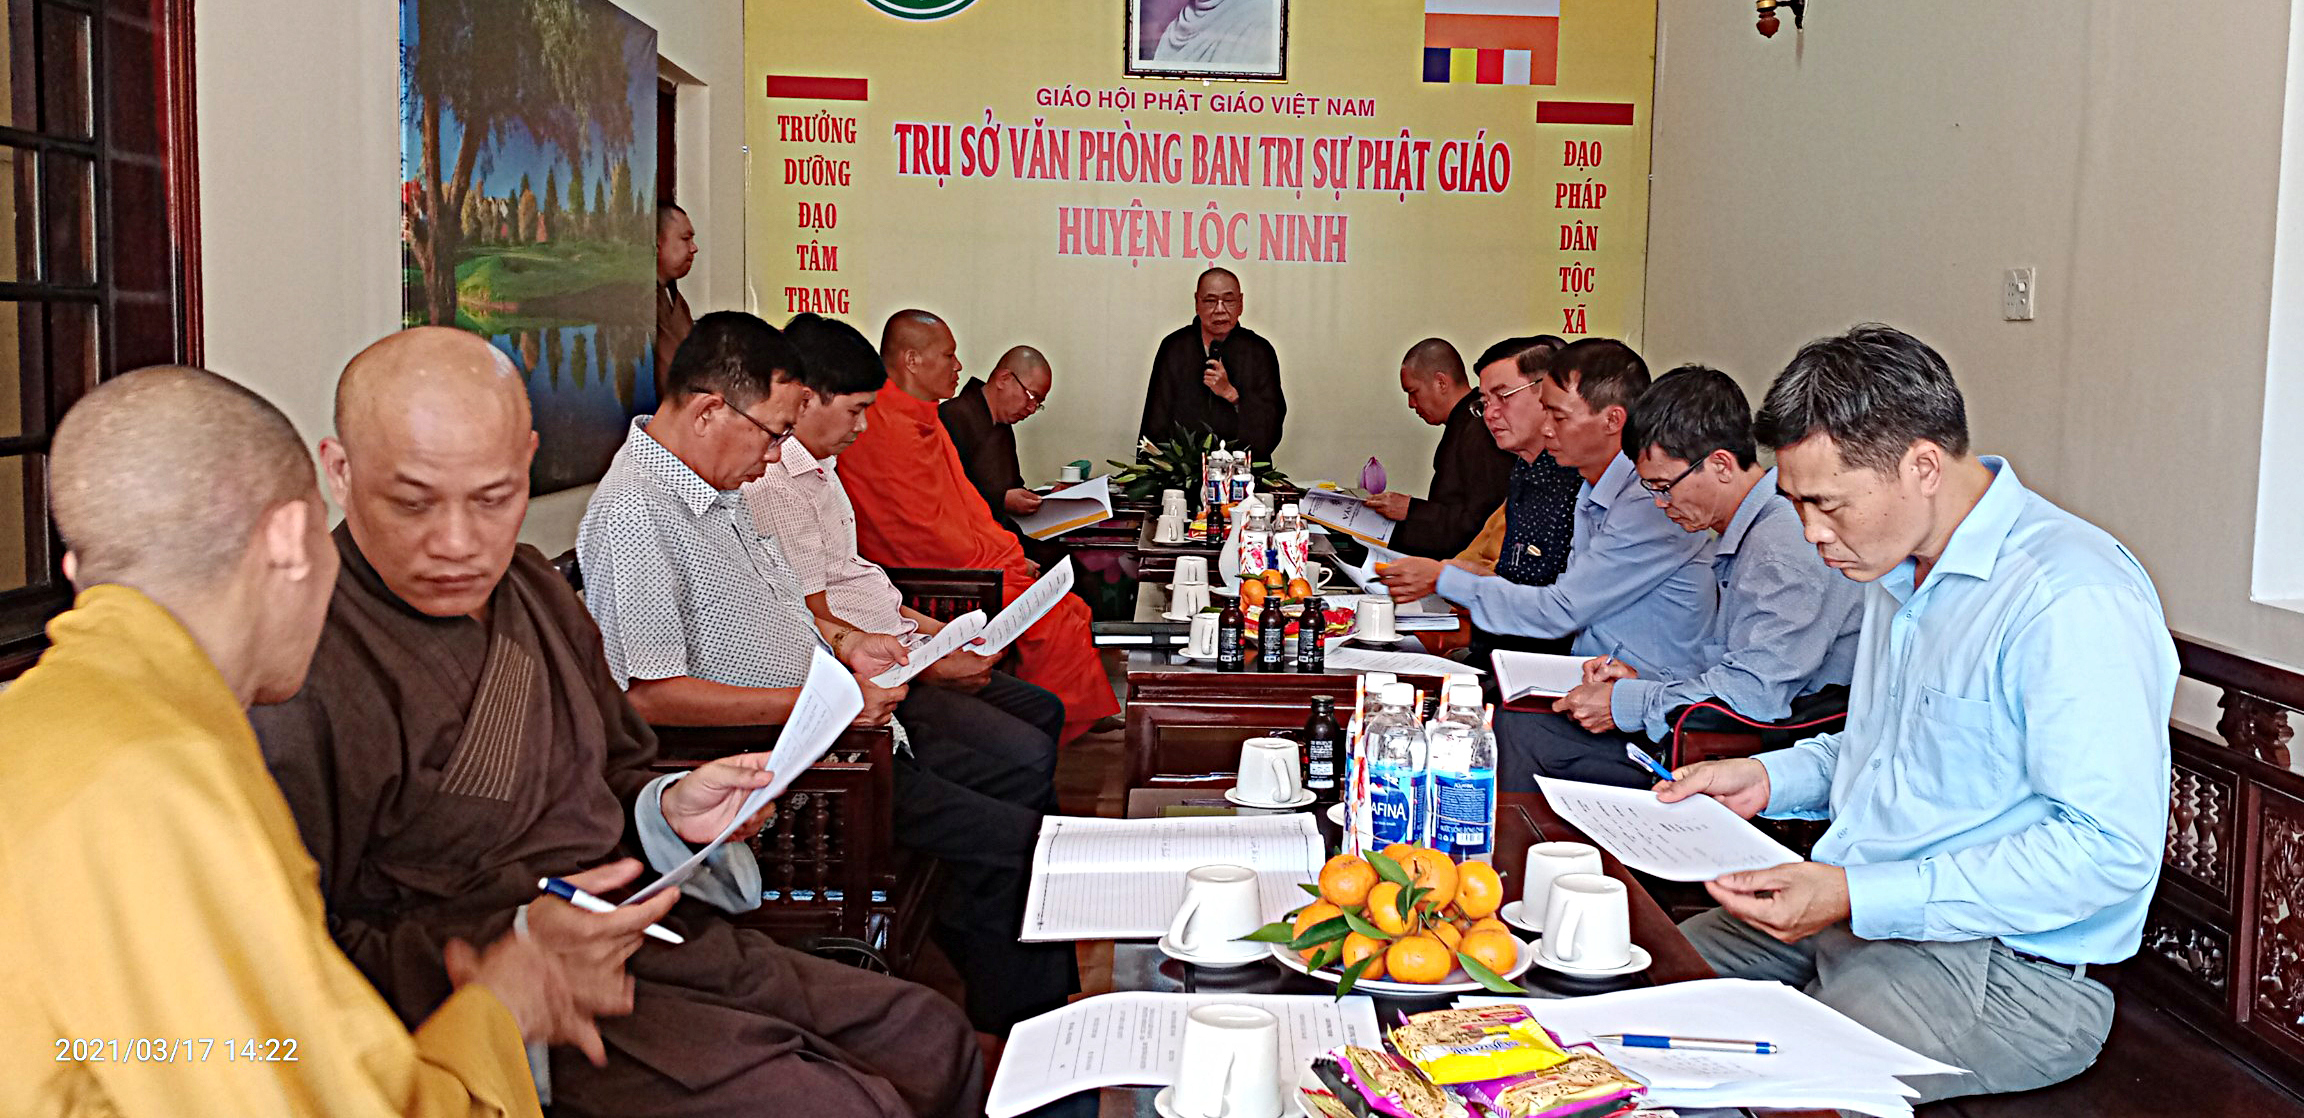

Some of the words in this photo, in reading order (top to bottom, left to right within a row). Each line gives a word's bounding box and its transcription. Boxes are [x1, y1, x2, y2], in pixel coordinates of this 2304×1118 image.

[1035, 85, 1092, 107] GIÁO
[1097, 88, 1137, 112] HỘI
[1143, 89, 1204, 114] PHẬT
[1209, 90, 1265, 114] GIÁO
[1271, 93, 1321, 118] VIỆT
[1327, 97, 1375, 117] NAM
[777, 110, 858, 143] TRƯỞNG
[783, 153, 852, 186] DƯỠNG
[894, 123, 951, 187] TRỤ
[960, 109, 1001, 177] SỞ
[1008, 117, 1070, 180] VĂN
[1079, 119, 1183, 184] PHÒNG
[1192, 133, 1251, 187] BAN
[1259, 135, 1305, 199] TRỊ
[1312, 135, 1353, 201] SỰ
[1357, 127, 1431, 203] PHẬT
[1438, 129, 1511, 193] GIÁO
[1562, 139, 1603, 170] ĐẠO
[1554, 178, 1608, 211] PHÁP
[797, 201, 838, 234] ĐẠO
[1059, 197, 1171, 267] HUYỆN
[1183, 201, 1249, 270] LỘC
[1259, 213, 1348, 263] NINH
[1559, 219, 1599, 252] DÂN
[795, 239, 838, 271] TÂM
[1558, 263, 1596, 297] TỘC
[784, 285, 850, 315] TRANG
[1562, 303, 1588, 334] XÃ
[1371, 802, 1407, 821] AFINA
